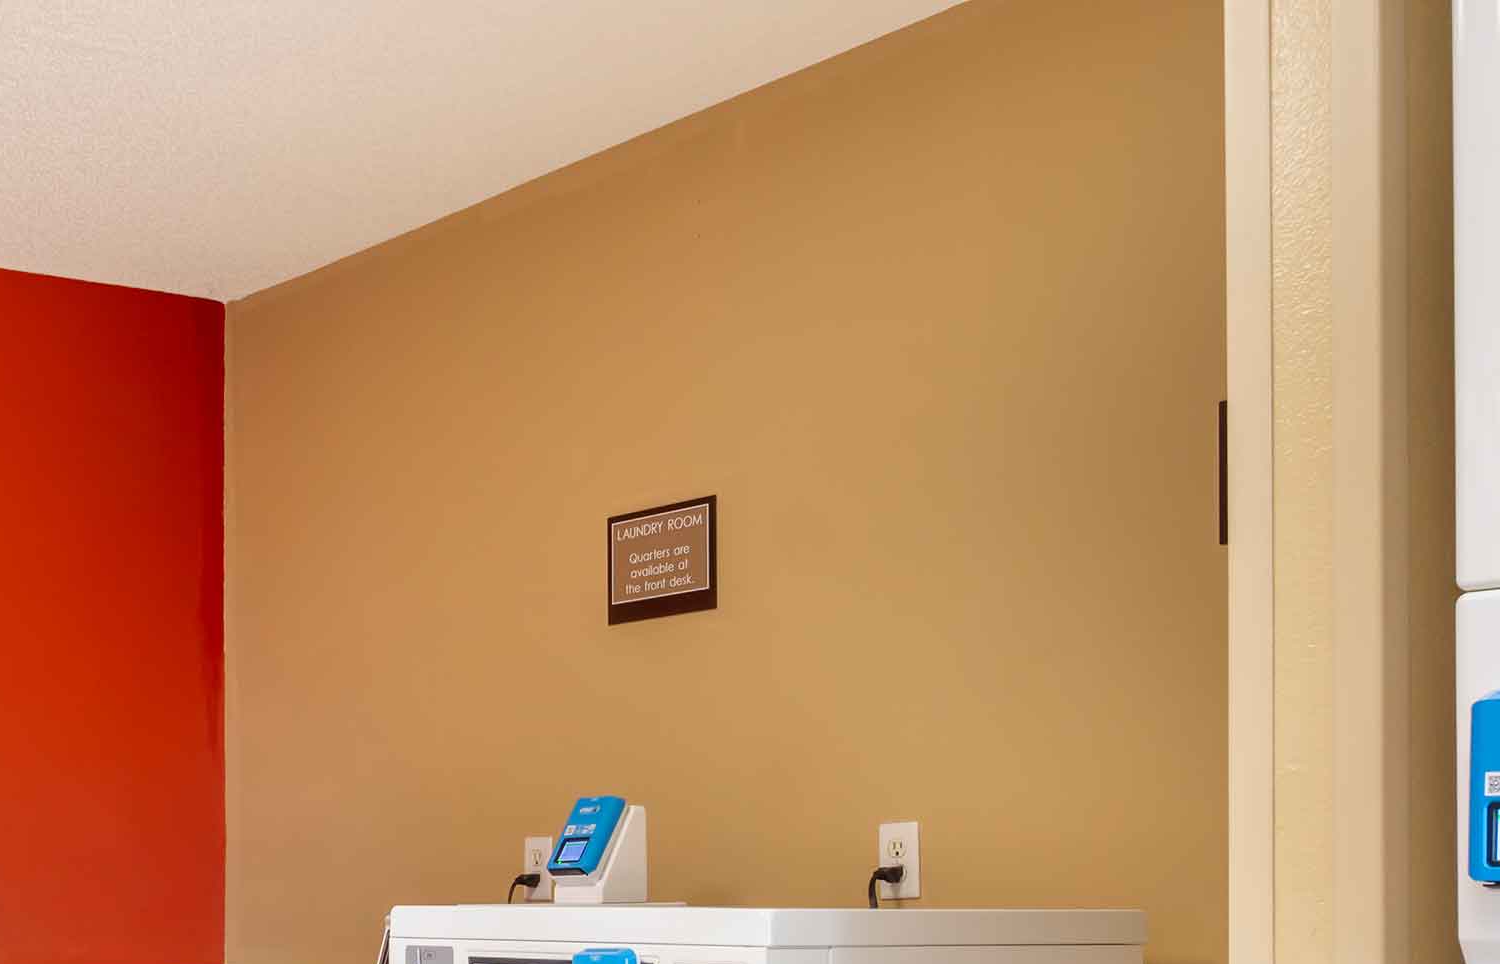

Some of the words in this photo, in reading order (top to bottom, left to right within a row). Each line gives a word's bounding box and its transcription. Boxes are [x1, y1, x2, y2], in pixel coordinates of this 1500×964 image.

[617, 521, 663, 541] LAUNDRY
[667, 513, 703, 531] ROOM
[629, 548, 670, 564] Quarters
[673, 545, 690, 556] are
[630, 561, 674, 578] available
[678, 560, 688, 570] at
[625, 583, 641, 595] the
[644, 579, 666, 592] front
[669, 574, 694, 588] desk.
